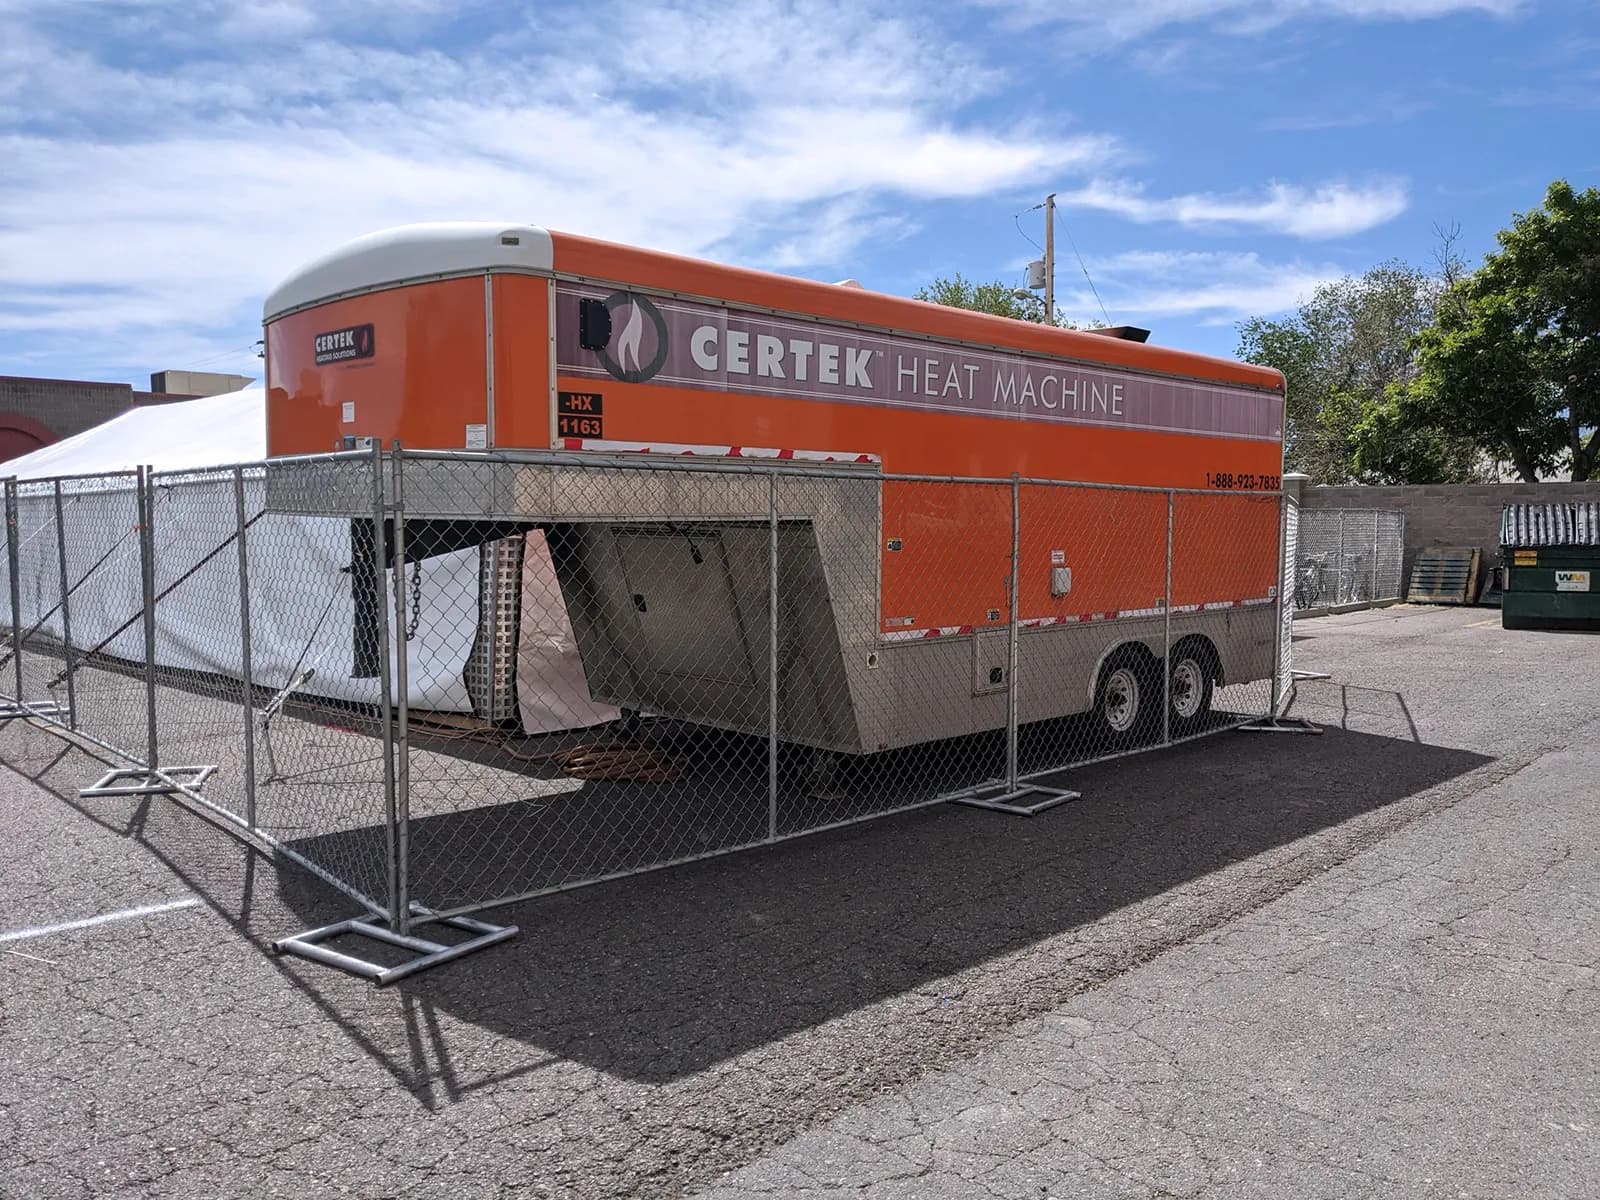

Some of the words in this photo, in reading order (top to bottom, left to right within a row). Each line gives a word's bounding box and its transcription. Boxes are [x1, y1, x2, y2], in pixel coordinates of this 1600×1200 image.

[315, 330, 354, 352] CERTEK
[690, 325, 873, 388] CERTEK
[897, 354, 981, 400] HEAT
[993, 368, 1123, 415] MACHINE
[560, 418, 601, 435] 1163
[1206, 472, 1280, 490] 1-888-923-7835
